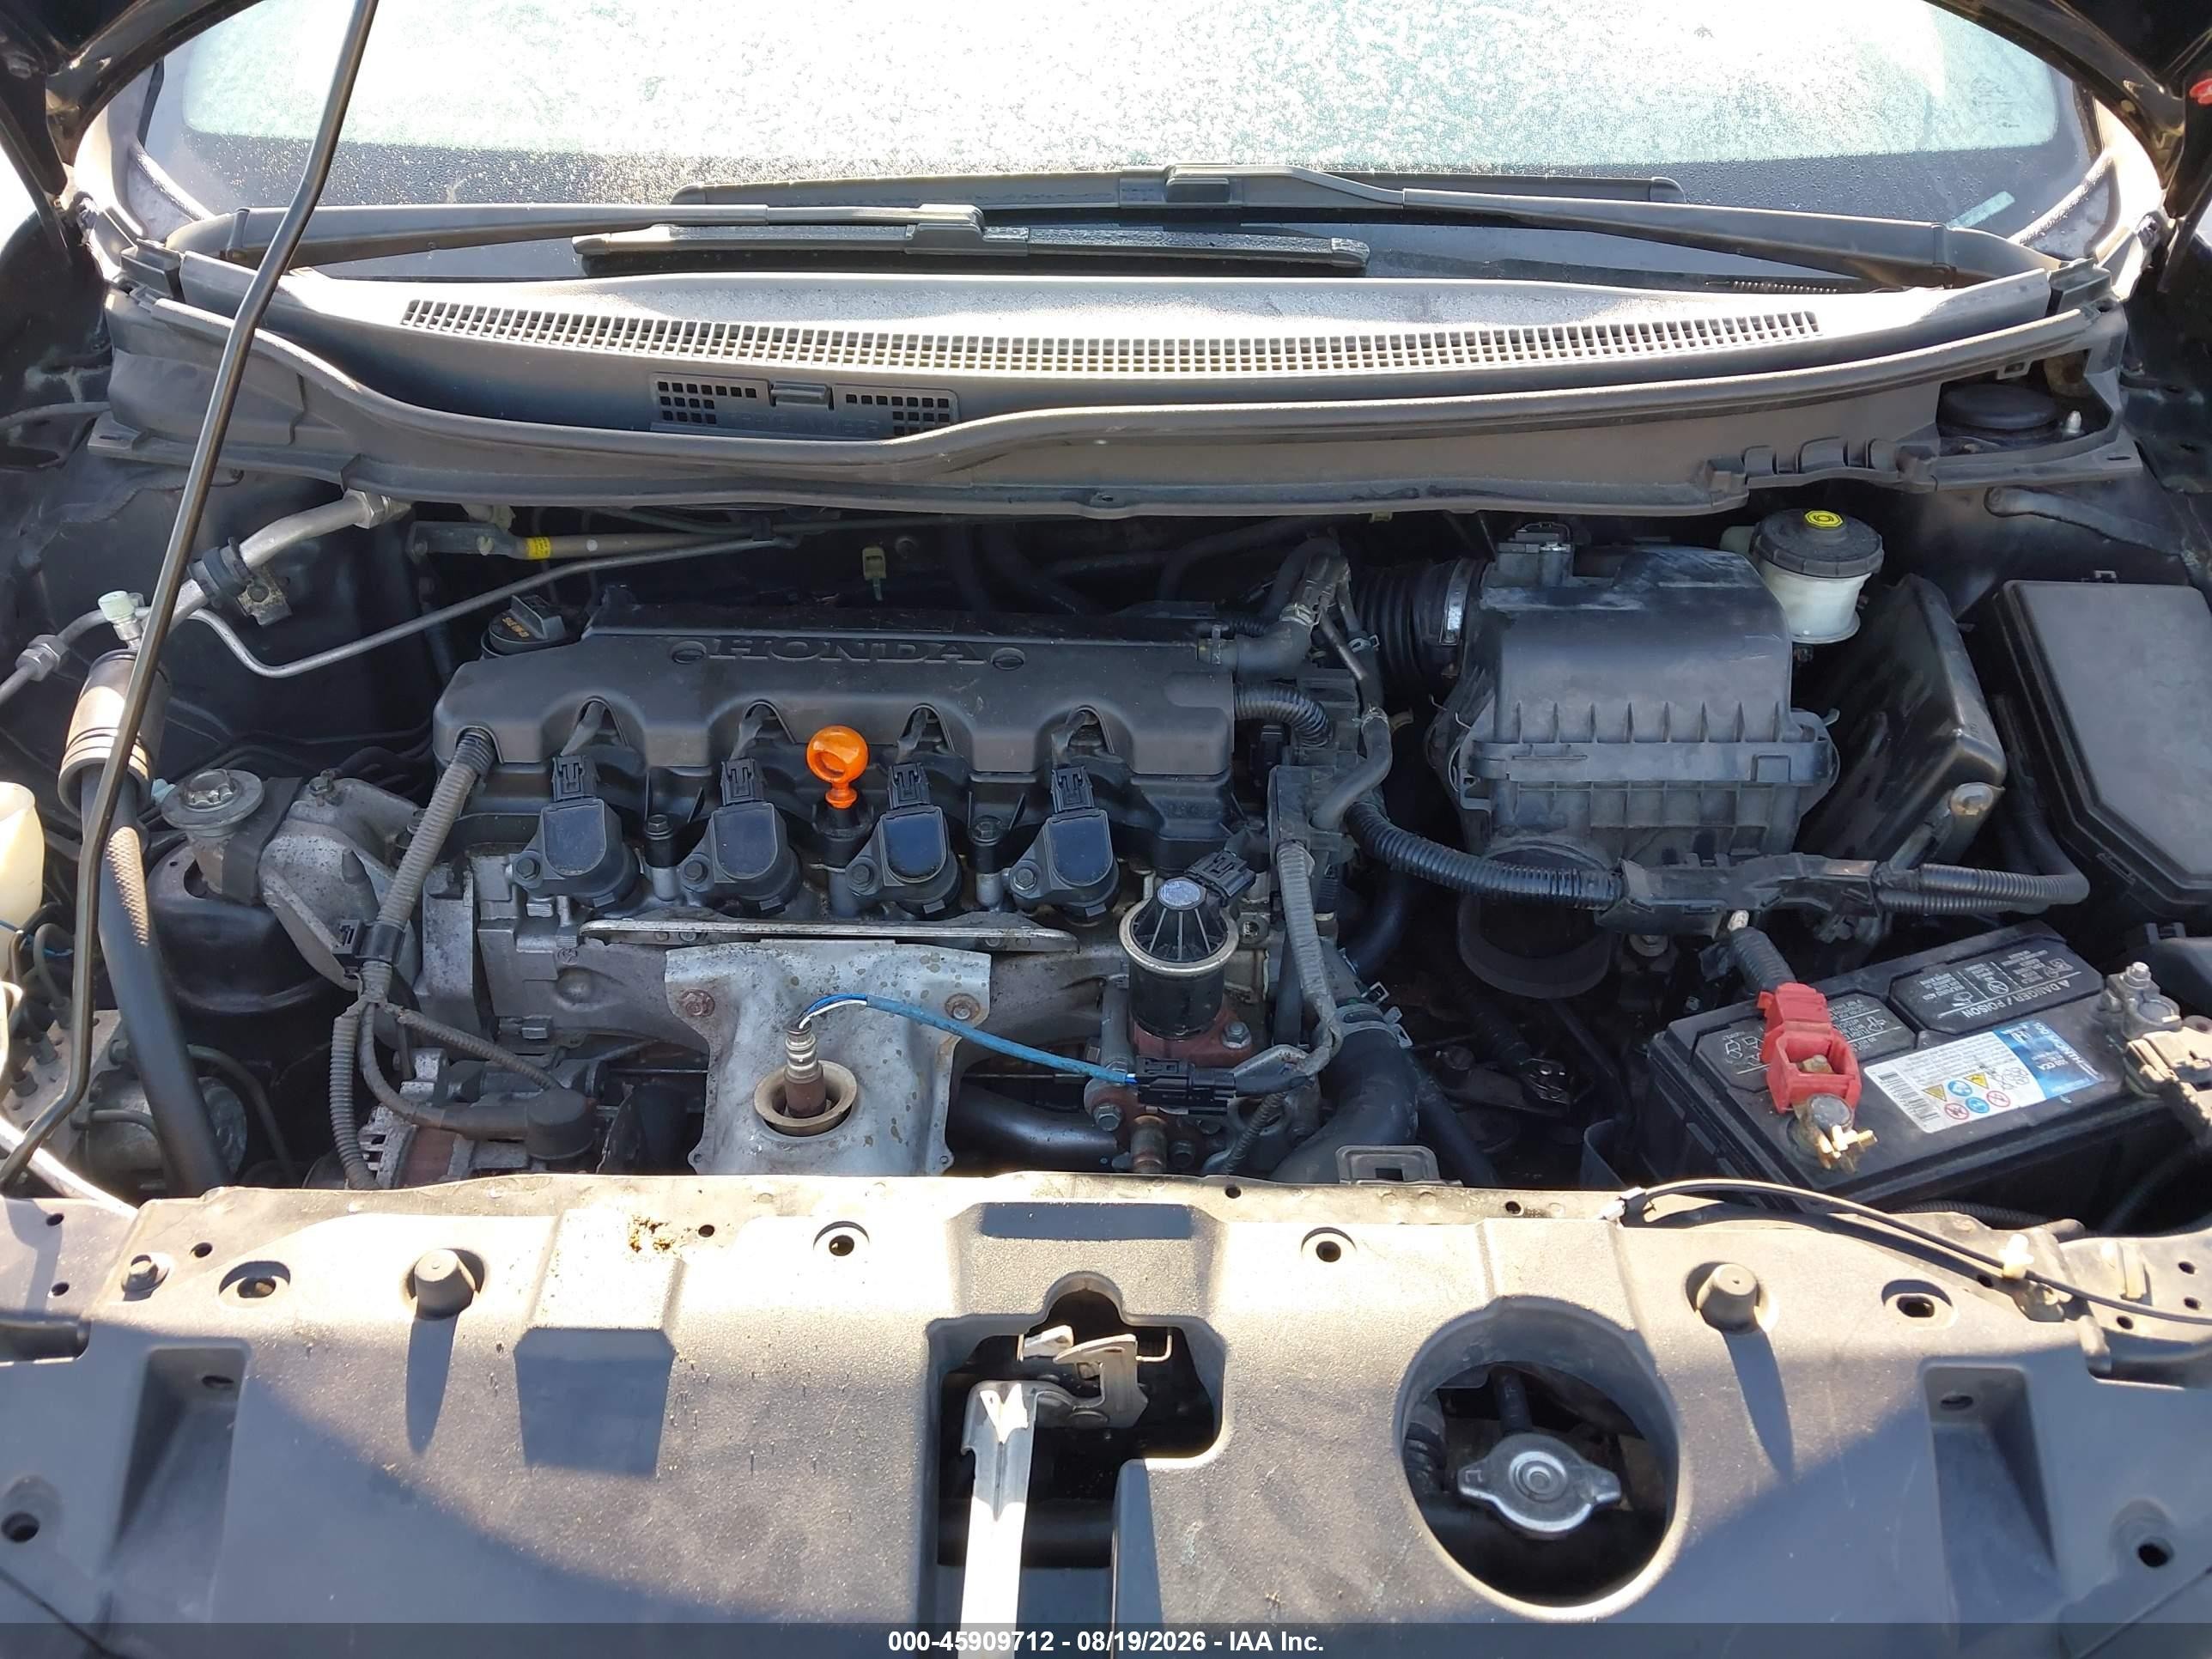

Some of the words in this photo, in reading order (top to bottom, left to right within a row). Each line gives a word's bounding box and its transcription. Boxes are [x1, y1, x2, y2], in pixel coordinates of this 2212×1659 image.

[708, 638, 985, 665] HONDA
[2012, 983, 2061, 1002] DANGER
[1961, 999, 2006, 1018] POISON
[2046, 1034, 2085, 1064] MONTH
